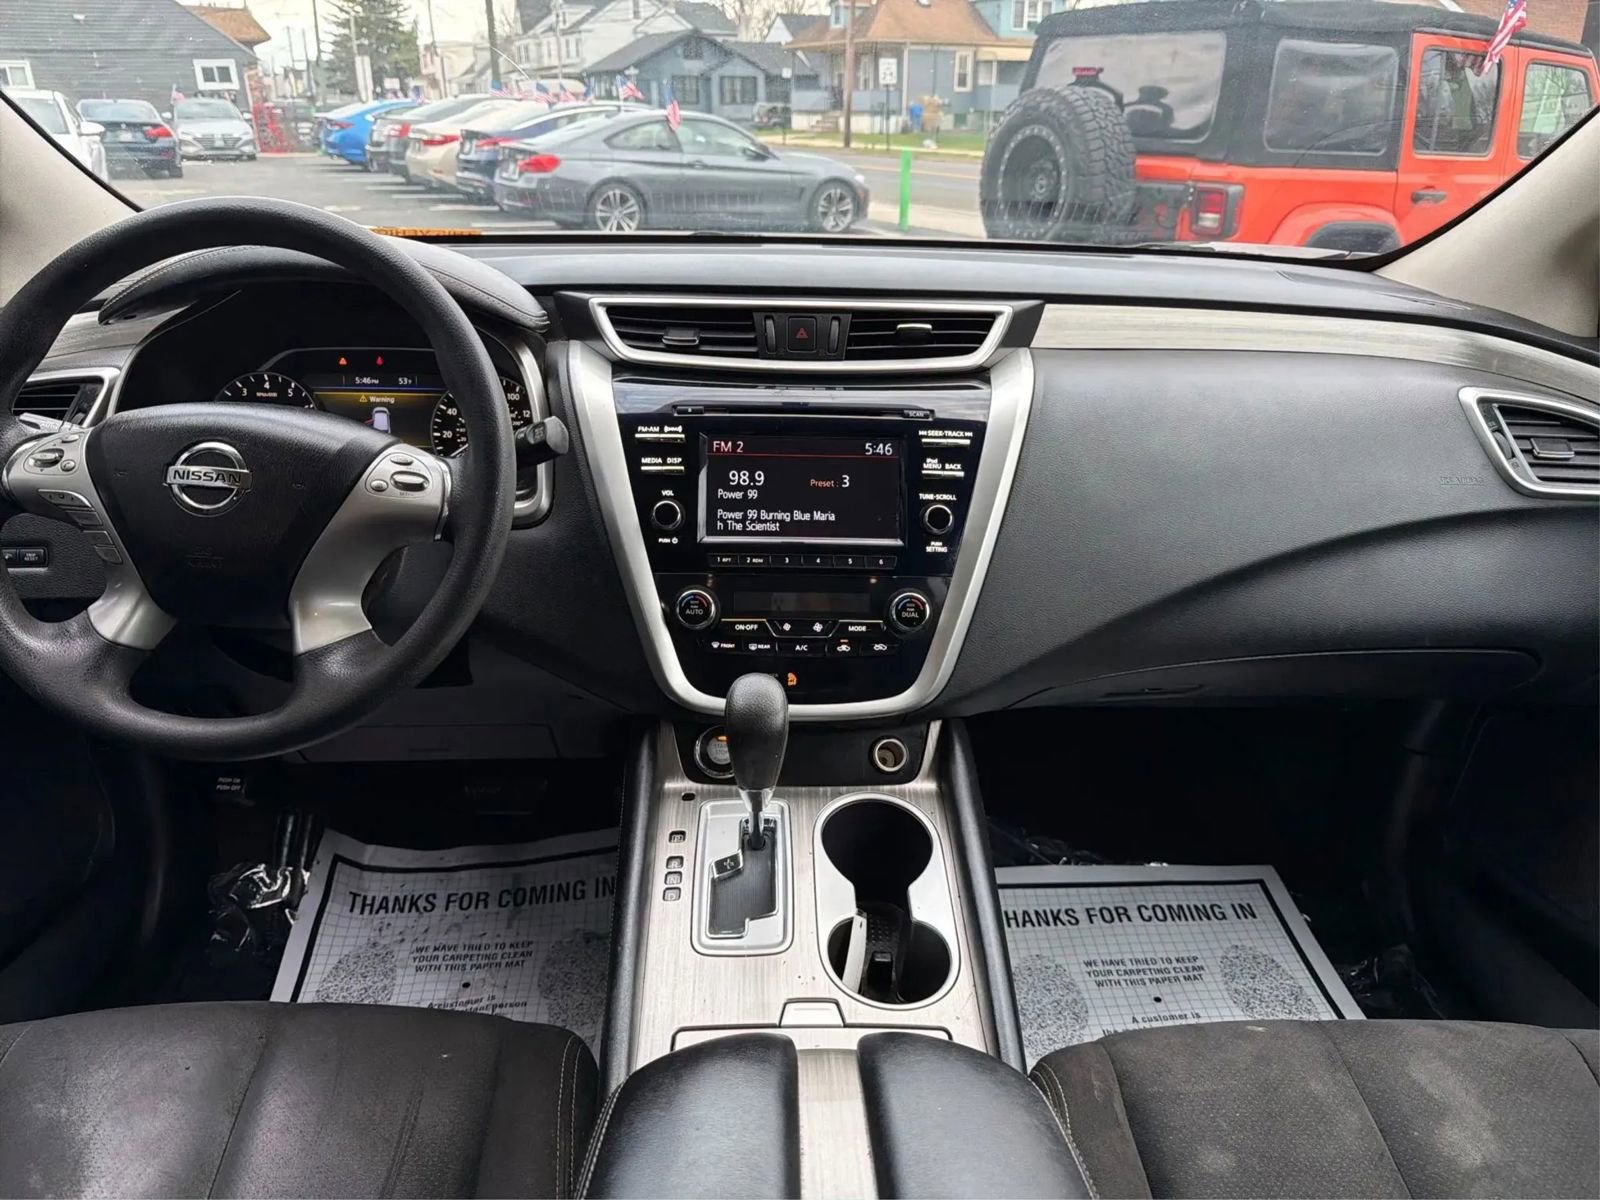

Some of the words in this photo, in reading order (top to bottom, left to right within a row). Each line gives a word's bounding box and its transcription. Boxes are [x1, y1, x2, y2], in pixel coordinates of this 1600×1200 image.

[263, 381, 270, 389] 4
[241, 388, 248, 396] 3
[288, 388, 293, 397] 5
[369, 396, 395, 404] Warning
[446, 407, 458, 416] 40
[522, 410, 531, 418] 12
[442, 430, 453, 438] 20
[712, 441, 732, 452] FM
[736, 441, 744, 453] 2
[865, 443, 893, 456] 5:46
[173, 469, 240, 483] NISSAN
[729, 470, 765, 486] 98.9
[841, 474, 850, 488] 3
[717, 488, 744, 499] Power
[747, 489, 758, 500] 99
[717, 508, 744, 519] Power
[747, 509, 758, 520] 99
[760, 509, 791, 522] Burning
[793, 509, 811, 521] Blue
[813, 510, 836, 521] Maria
[717, 520, 724, 531] h
[726, 520, 743, 531] The
[745, 520, 780, 531] Scientist
[349, 891, 437, 915] THANKS
[444, 891, 490, 912] FOR
[498, 880, 586, 908] COMING
[594, 876, 615, 899] IN
[1004, 908, 1080, 928] HANKS
[1085, 906, 1133, 924] FOR
[1136, 903, 1227, 922] COMING
[1231, 902, 1258, 920] IN
[433, 944, 459, 953] HAVE
[462, 943, 491, 951] TRIED
[494, 942, 506, 950] TO
[509, 940, 534, 949] KEEP
[412, 954, 440, 963] YOUR
[442, 952, 498, 962] CARPETING
[500, 950, 534, 959] CLEAN
[1083, 960, 1098, 968] WE
[1101, 959, 1128, 968] HAVE
[1129, 957, 1158, 966] TRIED
[1161, 957, 1173, 965] TO
[1174, 955, 1199, 964] KEEP
[415, 963, 442, 973] WITH
[445, 963, 467, 972] THIS
[470, 961, 502, 971] PAPER
[504, 960, 526, 968] MAT
[1086, 969, 1114, 978] YOUR
[1116, 967, 1171, 977] CARPETING
[1173, 965, 1205, 974] CLEAN
[1095, 979, 1121, 988] WITH
[1125, 978, 1147, 987] THIS
[1149, 976, 1181, 985] PAPER
[1183, 973, 1204, 982] MAT
[491, 1001, 528, 1015] person
[1132, 1016, 1139, 1024] A
[1141, 1012, 1188, 1023] customer
[1191, 1011, 1201, 1019] is
